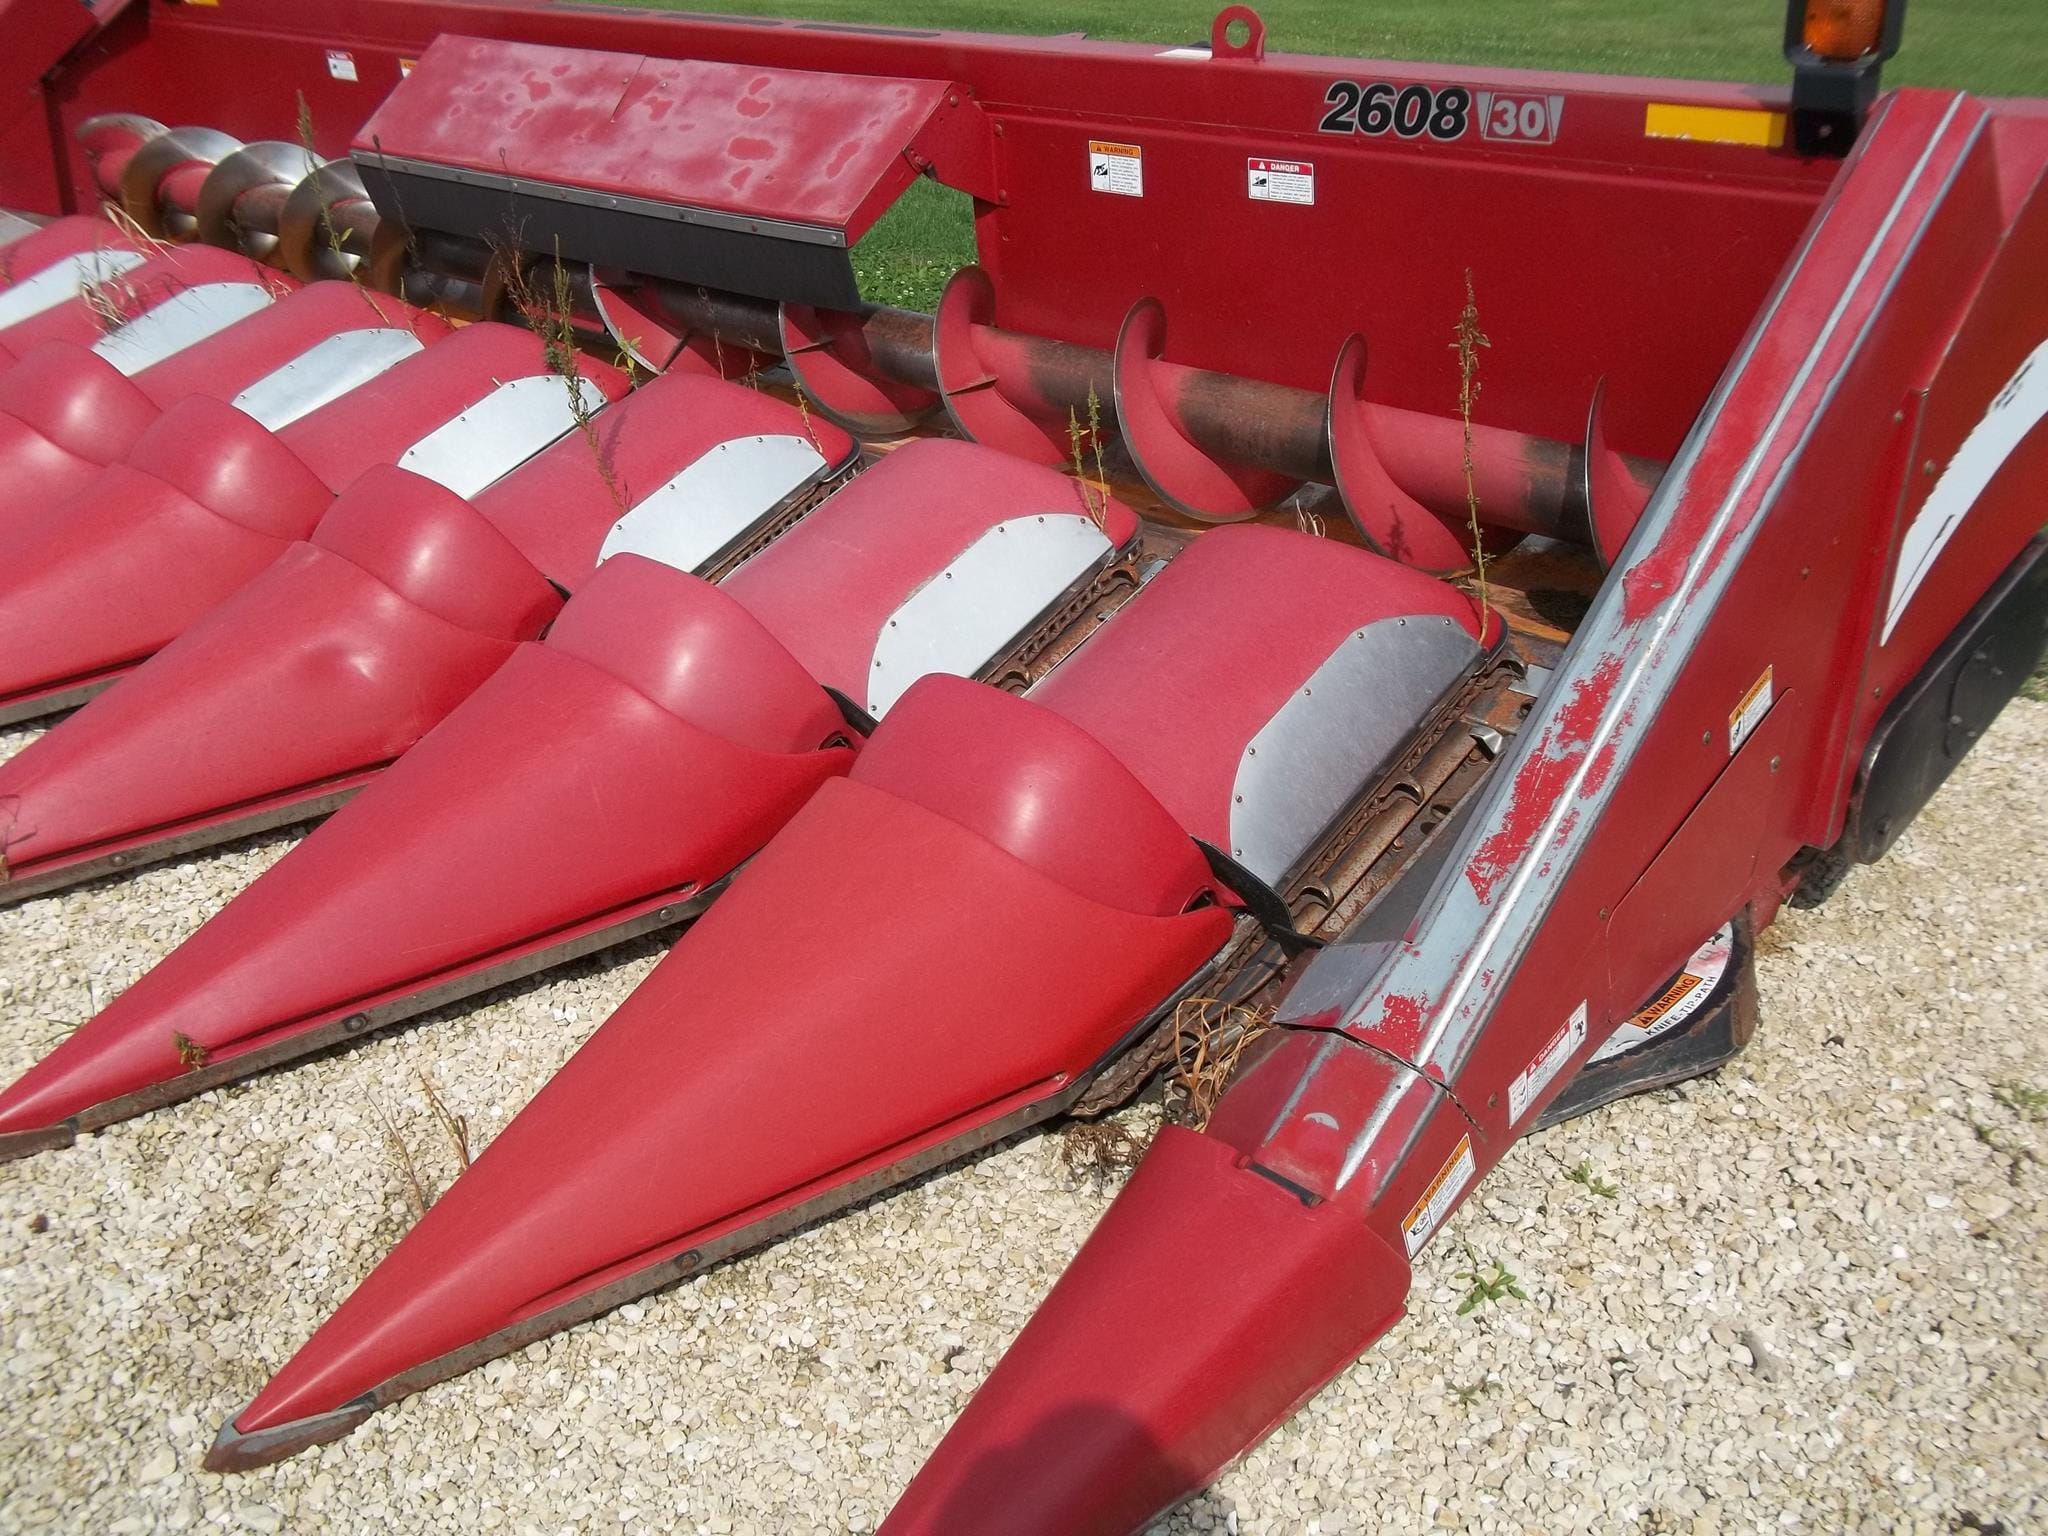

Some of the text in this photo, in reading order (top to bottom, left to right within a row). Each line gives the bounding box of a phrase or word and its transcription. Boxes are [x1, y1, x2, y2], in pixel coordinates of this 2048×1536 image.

[1318, 80, 1546, 141] 2608 30
[1104, 146, 1134, 156] WARNING
[1270, 163, 1300, 173] DANGER
[1650, 977, 1695, 1016] WARNING
[1538, 1027, 1566, 1062] DANGER
[1424, 1151, 1461, 1202] WARNING
